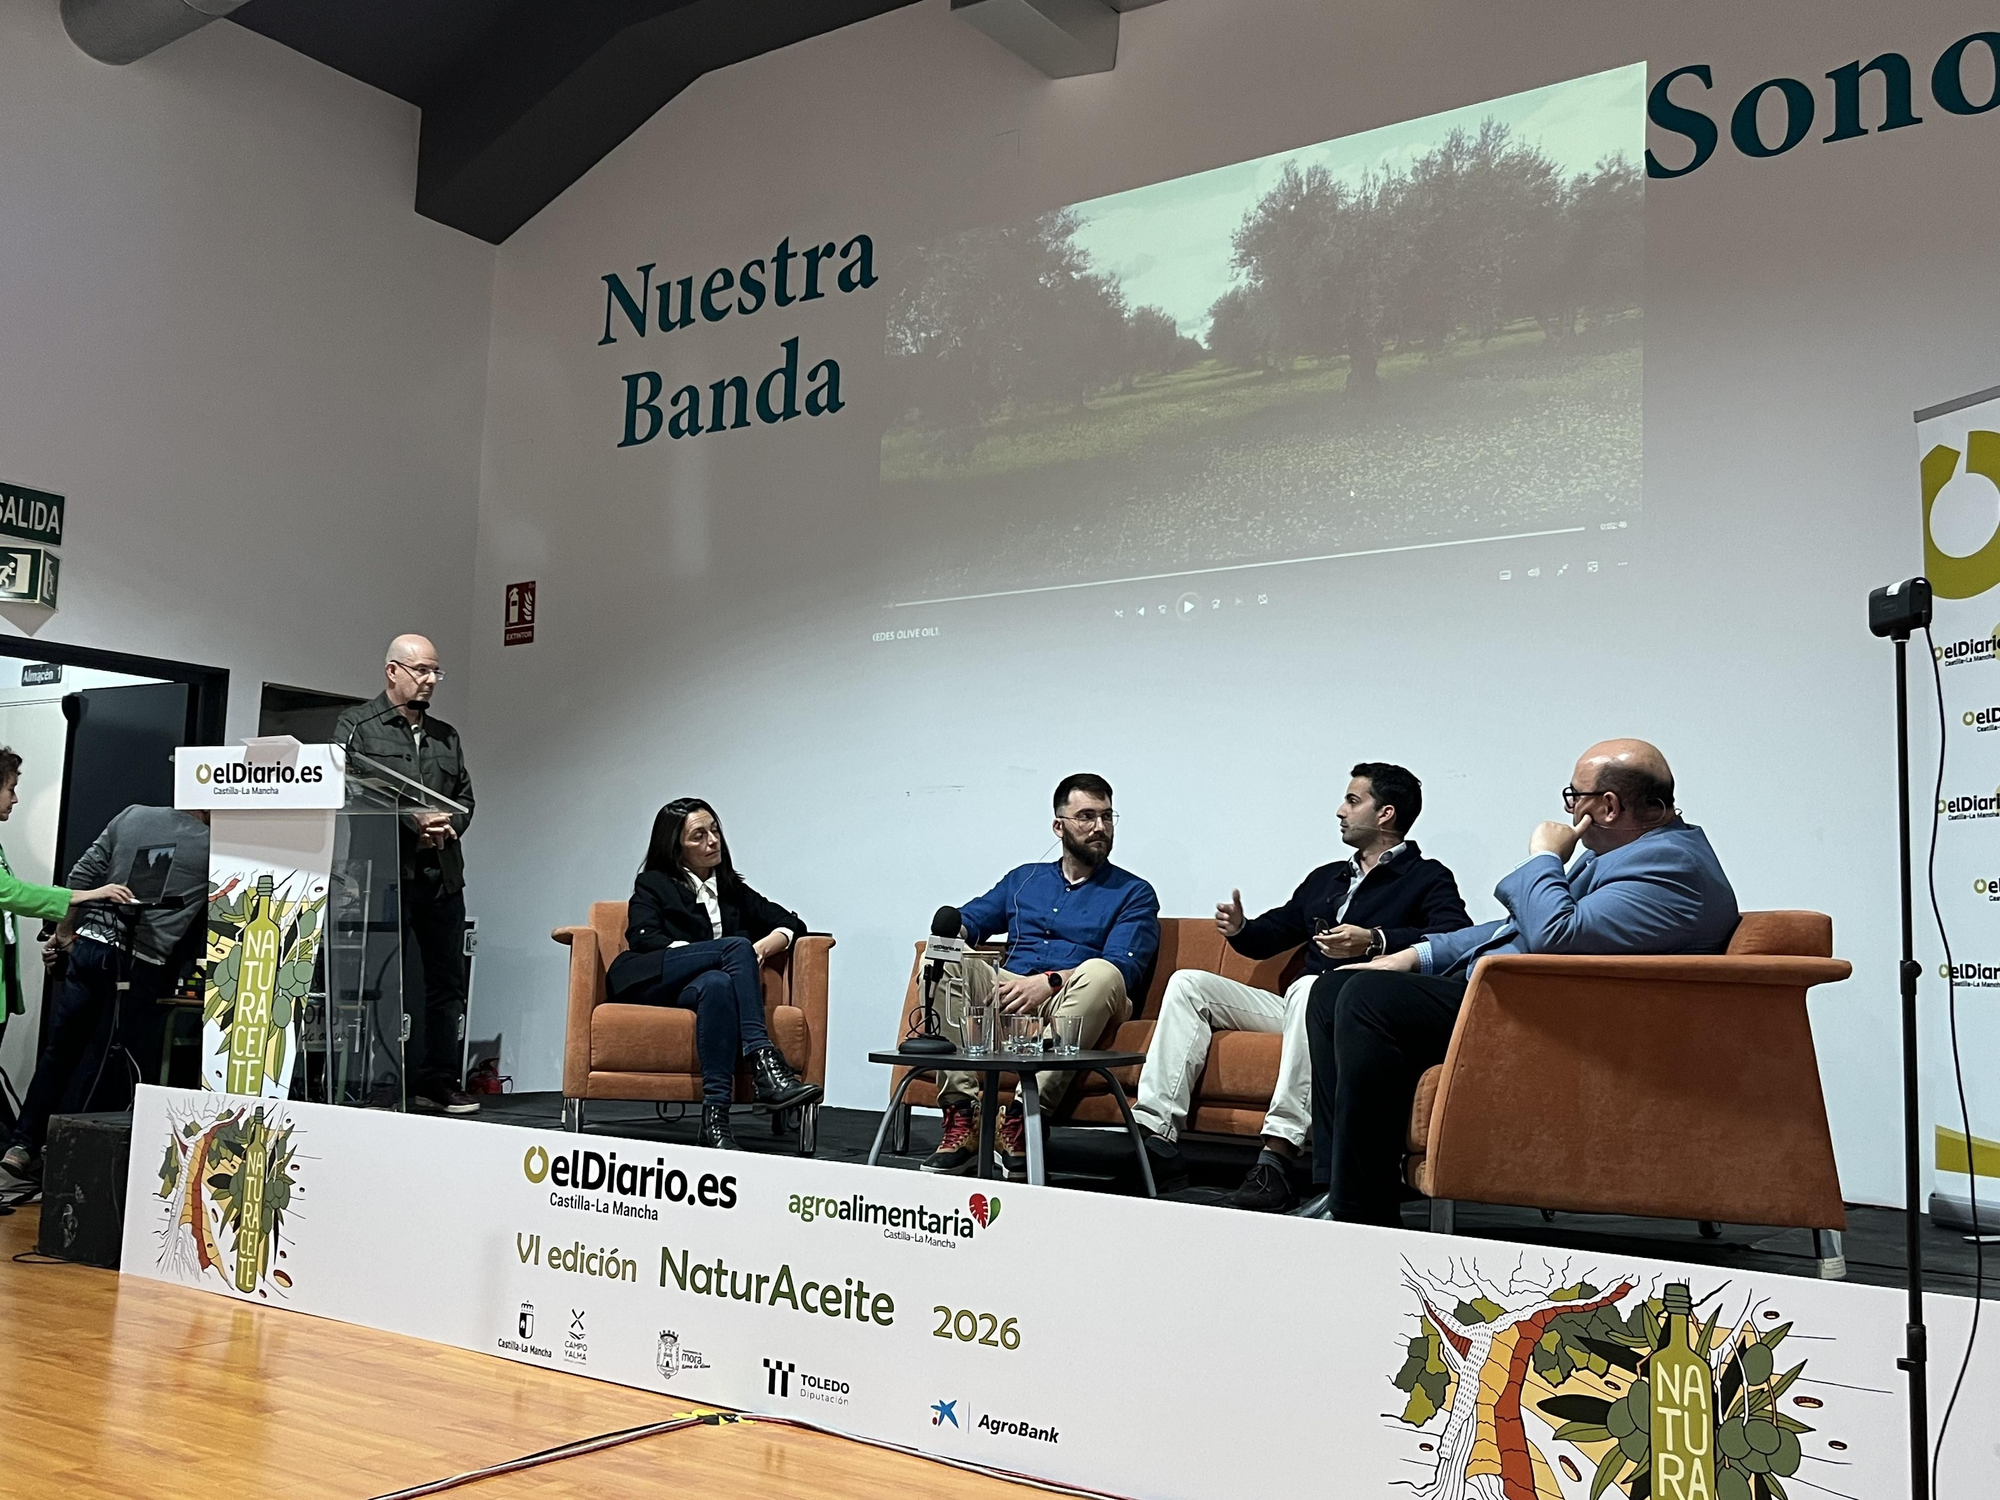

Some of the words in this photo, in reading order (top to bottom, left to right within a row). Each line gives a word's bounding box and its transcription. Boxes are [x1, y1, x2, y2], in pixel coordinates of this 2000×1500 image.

[1644, 31, 2000, 179] Sono
[598, 234, 878, 346] Nuestra
[617, 336, 845, 448] Banda
[506, 630, 532, 641] EXTINTOR
[896, 628, 920, 640] OLIVE
[213, 761, 323, 784] elDiario.es
[213, 787, 250, 795] Castilla-La
[252, 786, 279, 795] Mancha
[246, 929, 275, 959] NA
[243, 961, 275, 991] TU
[238, 992, 268, 1024] RA
[233, 1025, 266, 1058] CEI
[232, 1059, 261, 1096] TE
[246, 1151, 264, 1176] NA
[245, 1176, 263, 1202] TU
[551, 1149, 738, 1209] elDiario.es
[242, 1203, 260, 1230] RA
[550, 1192, 609, 1214] Castilla-La
[612, 1203, 659, 1221] Mancha
[788, 1193, 974, 1239] agroalimentaria
[240, 1230, 259, 1258] CEI
[883, 1228, 924, 1243] Castilla-La
[925, 1234, 956, 1249] Mancha
[238, 1257, 256, 1288] TE
[517, 1232, 541, 1266] VI
[547, 1241, 637, 1283] edición
[659, 1246, 895, 1326] NaturAceite
[933, 1305, 1021, 1350] 2026
[498, 1338, 529, 1353] Castilla-La
[530, 1344, 552, 1358] Mancha
[564, 1340, 588, 1352] CAMPO
[564, 1350, 587, 1361] YALMA
[681, 1353, 702, 1365] mora
[800, 1373, 850, 1394] TOLEDO
[800, 1388, 849, 1406] Diputación
[1657, 1361, 1706, 1410] NA
[977, 1413, 1060, 1444] AgroBank
[1657, 1406, 1708, 1456] TU
[1658, 1452, 1710, 1500] RA
